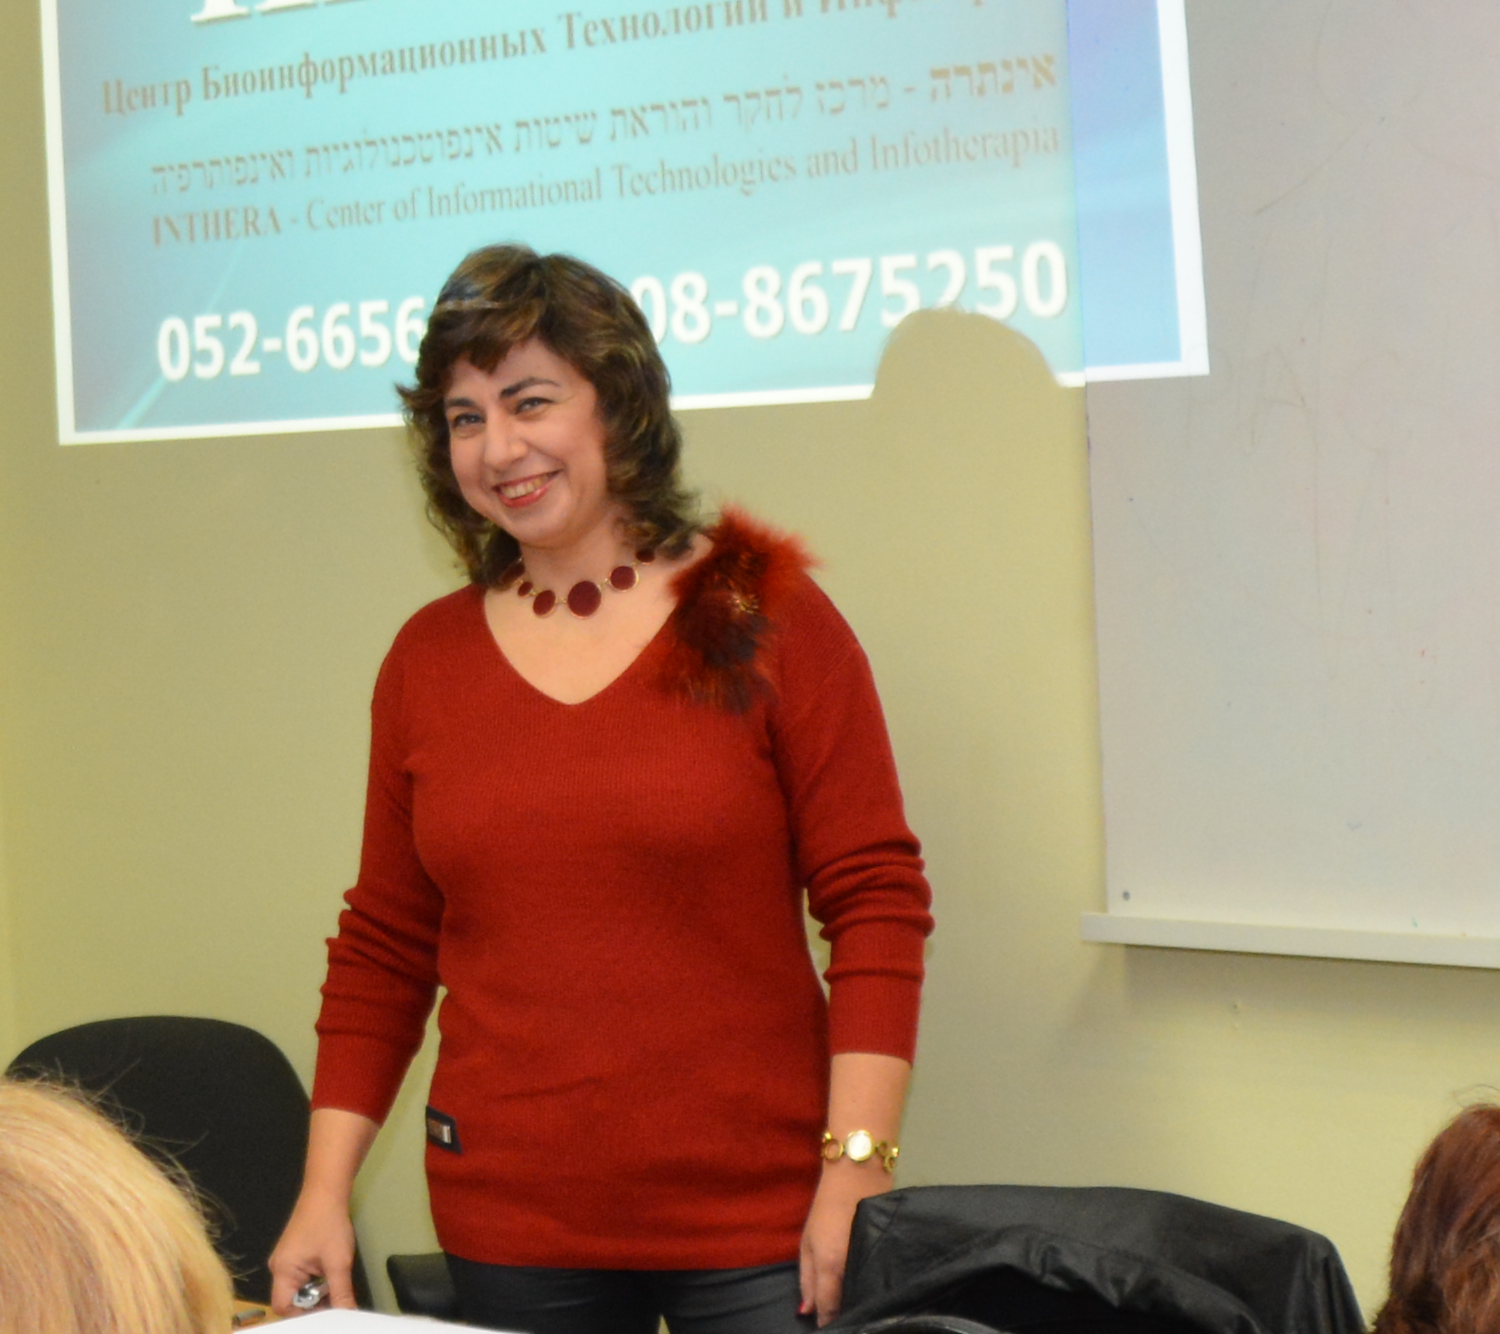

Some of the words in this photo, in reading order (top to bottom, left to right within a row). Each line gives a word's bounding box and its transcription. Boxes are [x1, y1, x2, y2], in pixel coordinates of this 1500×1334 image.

[102, 77, 192, 117] Центр
[202, 26, 548, 101] Биоинформационных
[815, 75, 890, 116] מרכז
[930, 53, 1057, 102] אינתרה
[610, 97, 714, 143] והוראת
[723, 72, 803, 135] לחקר
[514, 111, 598, 155] שיטות
[152, 204, 283, 247] INTHERA
[306, 197, 385, 232] Center
[393, 187, 423, 223] of
[427, 166, 603, 218] Informational
[614, 147, 797, 198] Technologies
[807, 137, 860, 178] and
[870, 115, 1061, 171] Infotherapia
[156, 296, 432, 383] 052-6656
[629, 239, 1069, 348] 08-8675250
